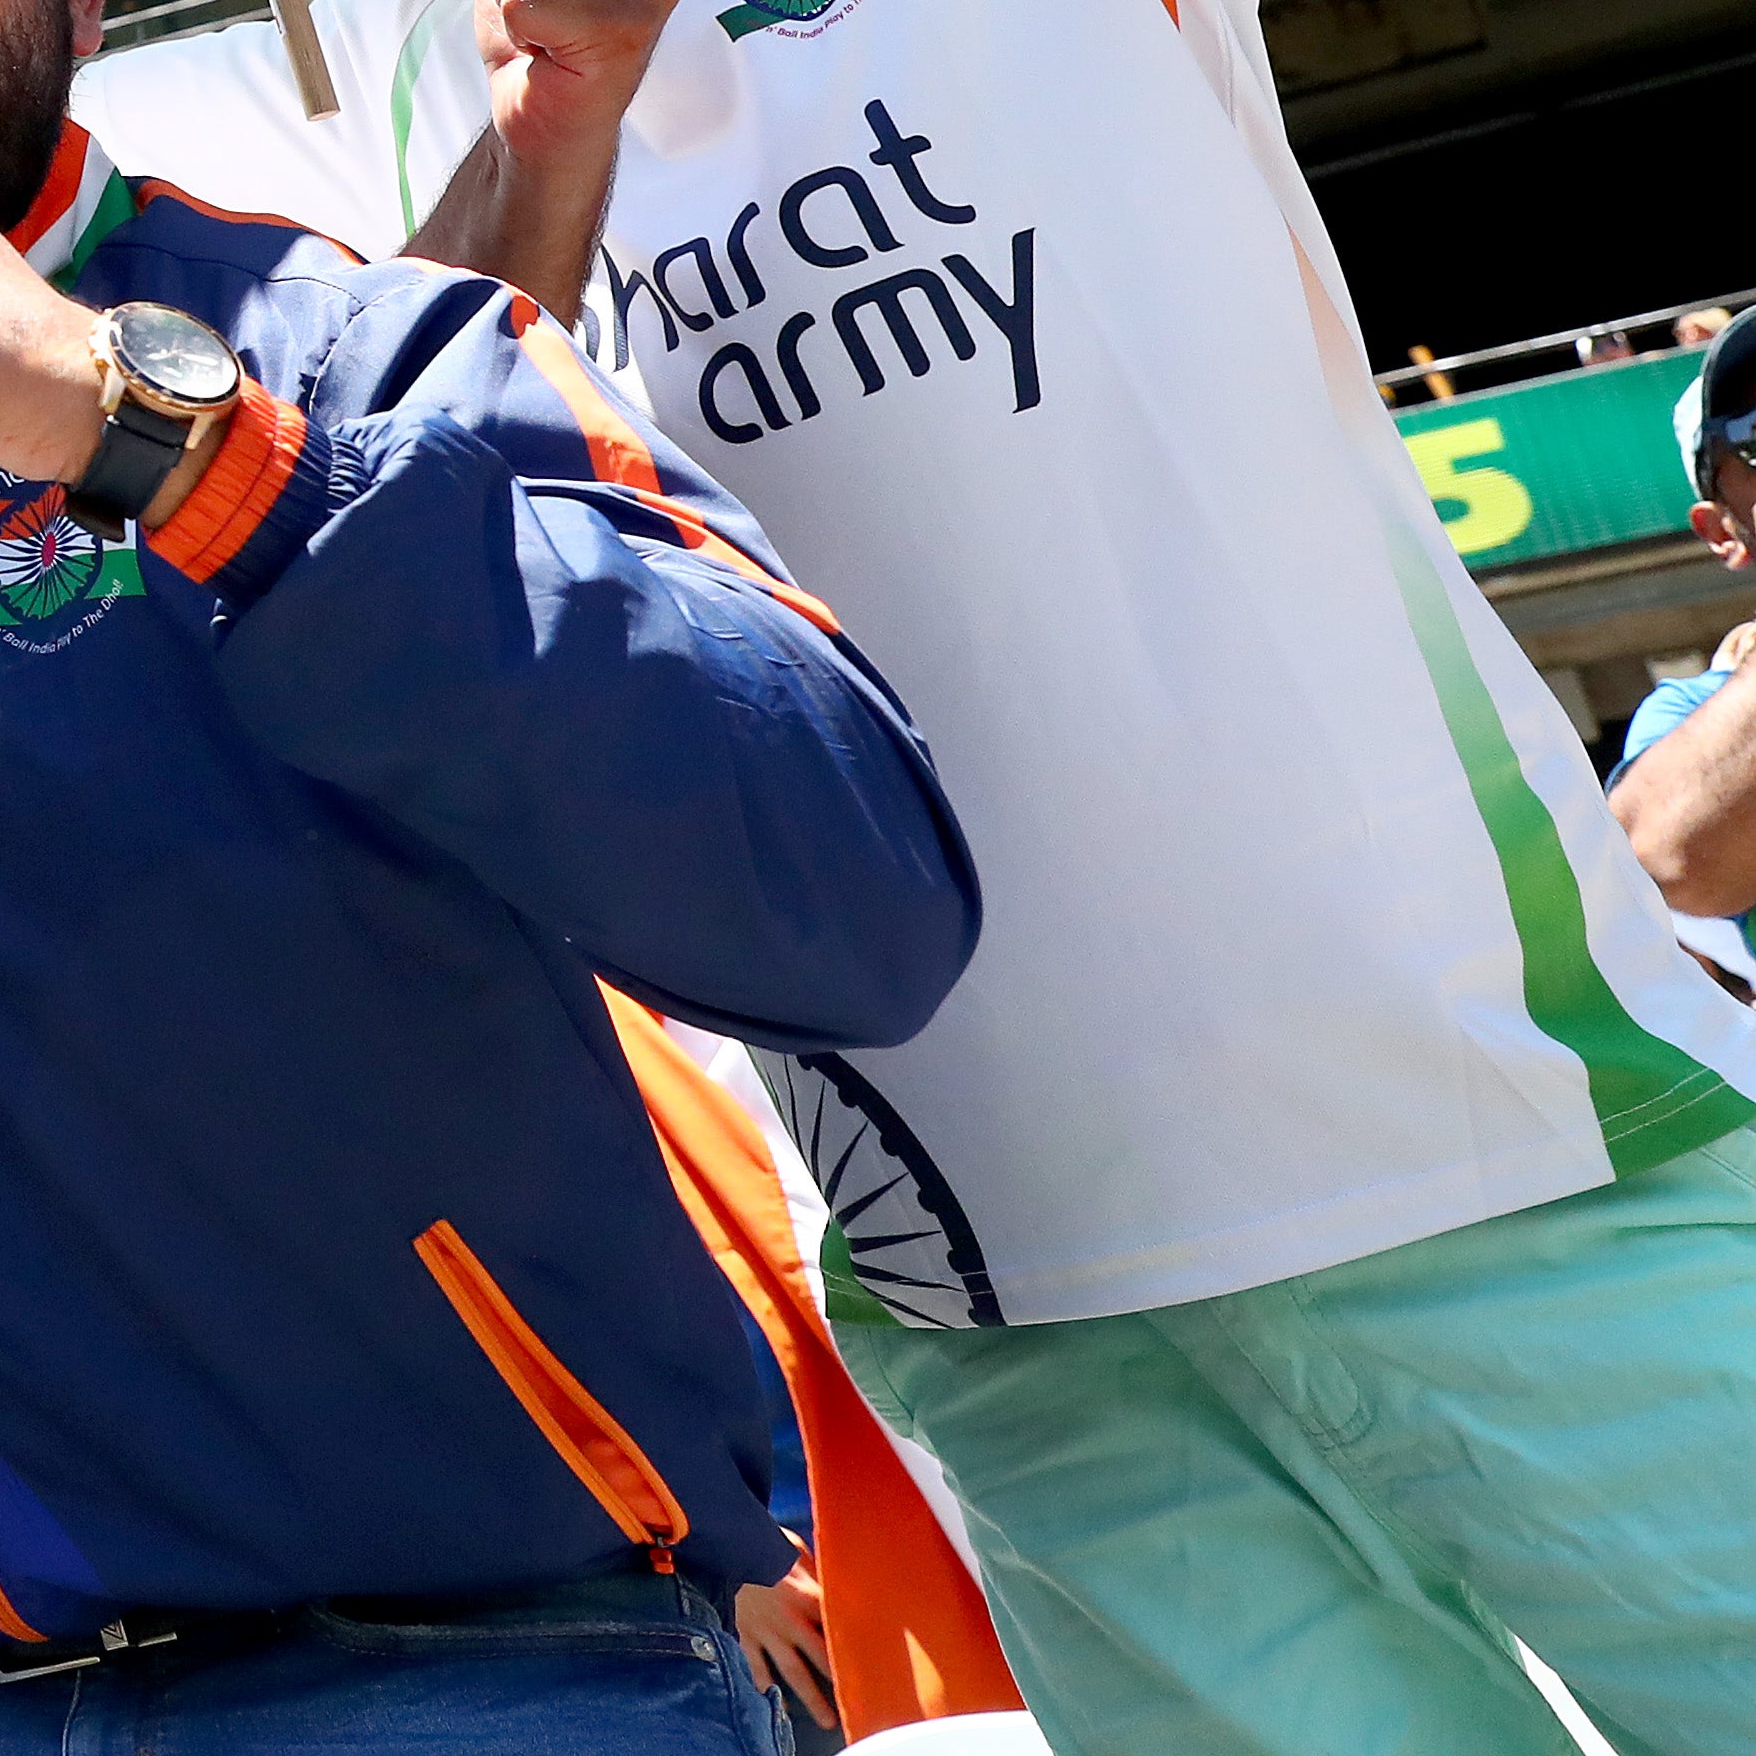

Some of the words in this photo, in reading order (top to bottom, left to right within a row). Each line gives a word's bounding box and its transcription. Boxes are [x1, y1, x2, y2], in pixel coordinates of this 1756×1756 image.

[697, 227, 1041, 445] army
[72, 624, 84, 638] to
[82, 608, 105, 628] The
